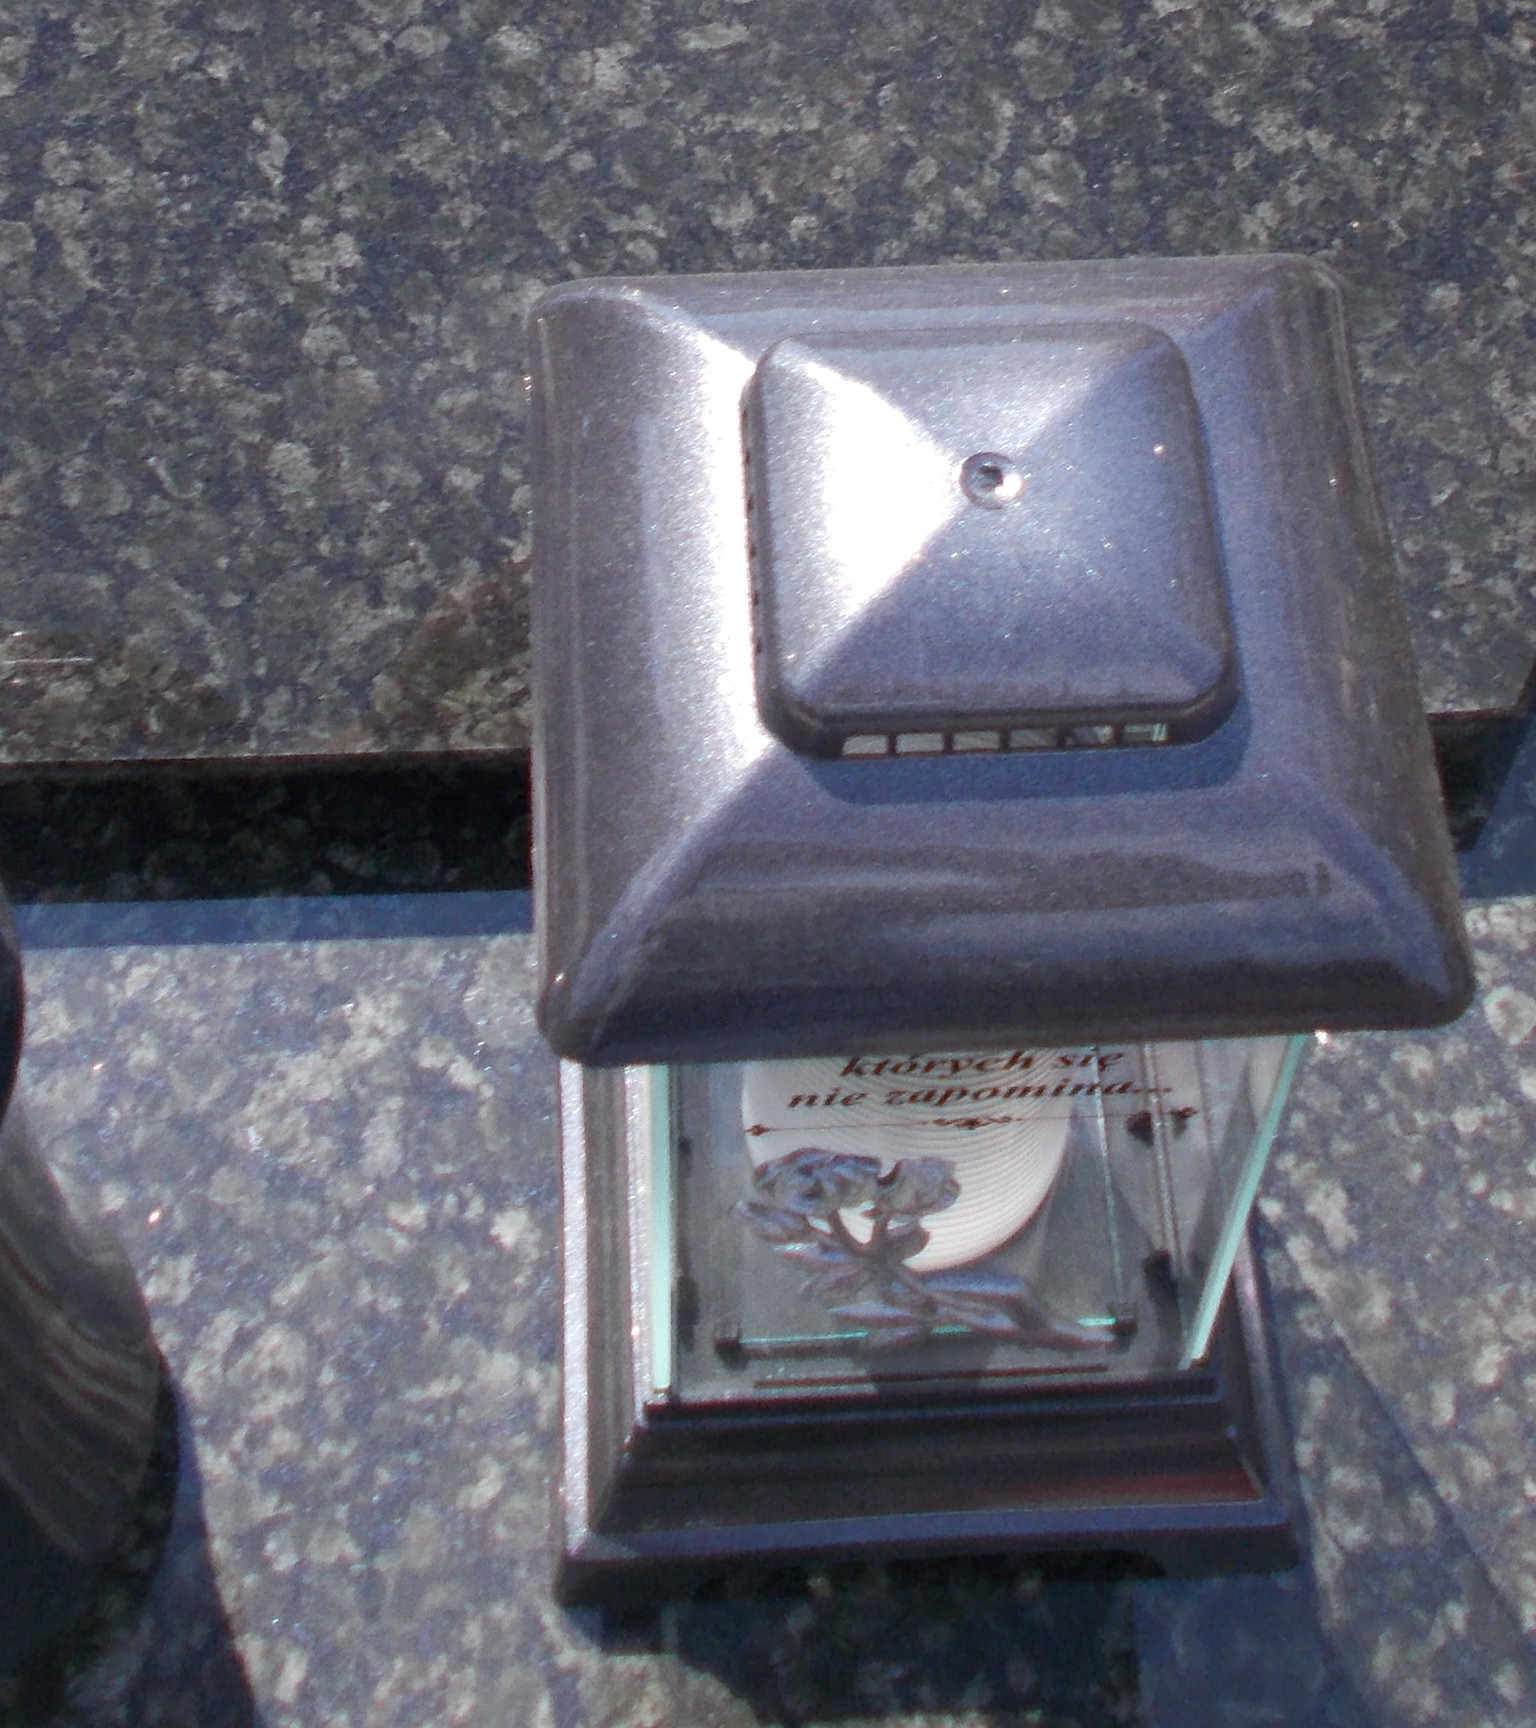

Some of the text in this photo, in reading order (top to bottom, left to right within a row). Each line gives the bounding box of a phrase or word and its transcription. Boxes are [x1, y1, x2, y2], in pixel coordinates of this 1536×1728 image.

[840, 1049, 1126, 1079] których się
[787, 1087, 866, 1109] nie
